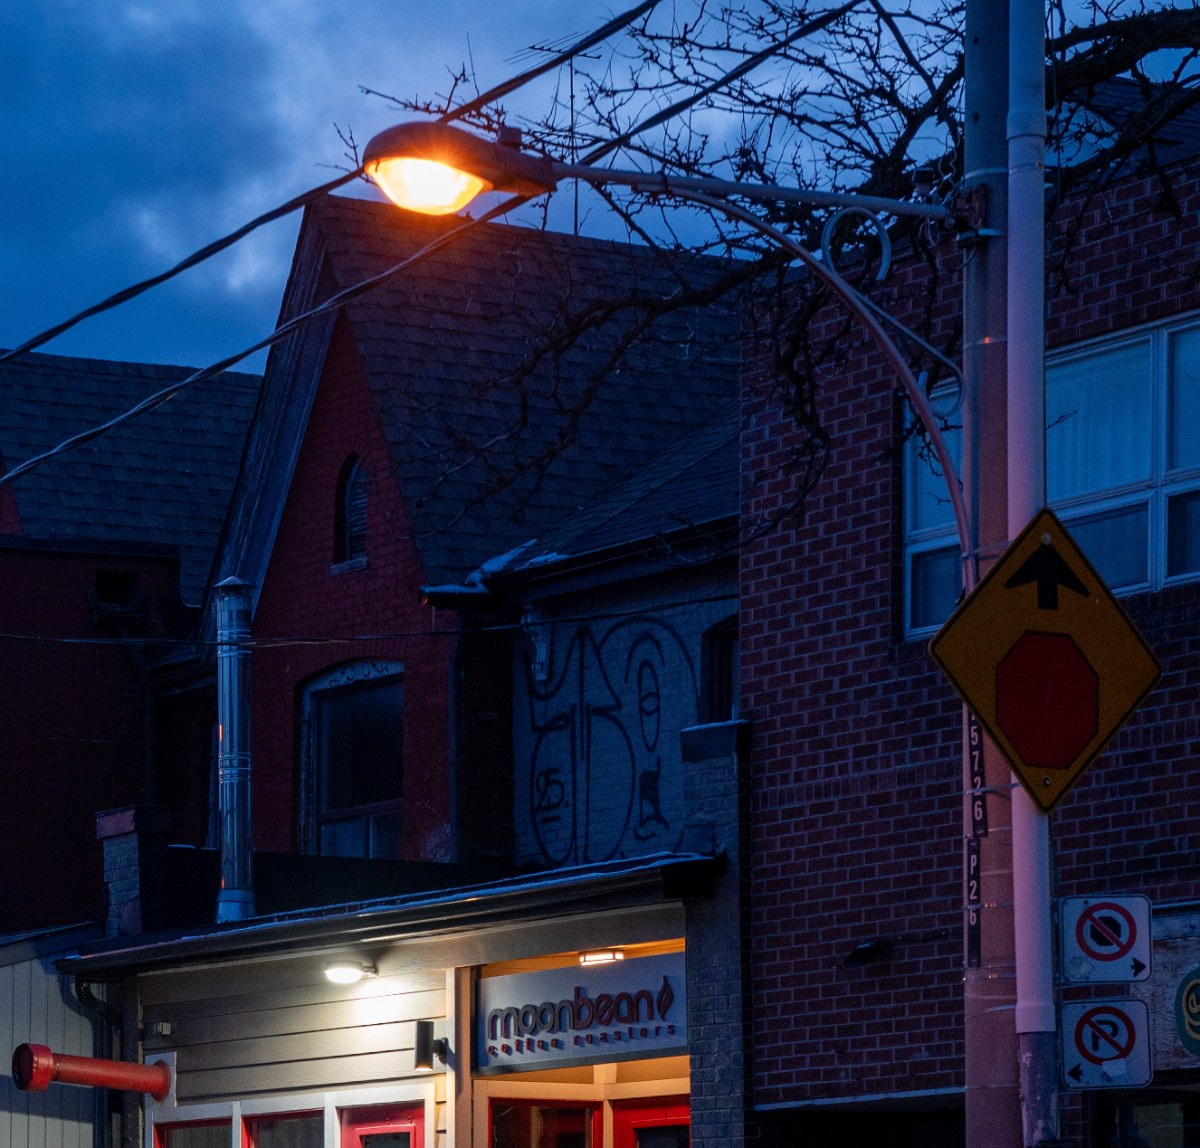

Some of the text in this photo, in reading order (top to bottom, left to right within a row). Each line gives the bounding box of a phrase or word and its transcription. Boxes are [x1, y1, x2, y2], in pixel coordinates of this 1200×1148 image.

[969, 713, 984, 822] 5726
[487, 986, 654, 1040] moonbean
[488, 1024, 676, 1056] coffee roasters
